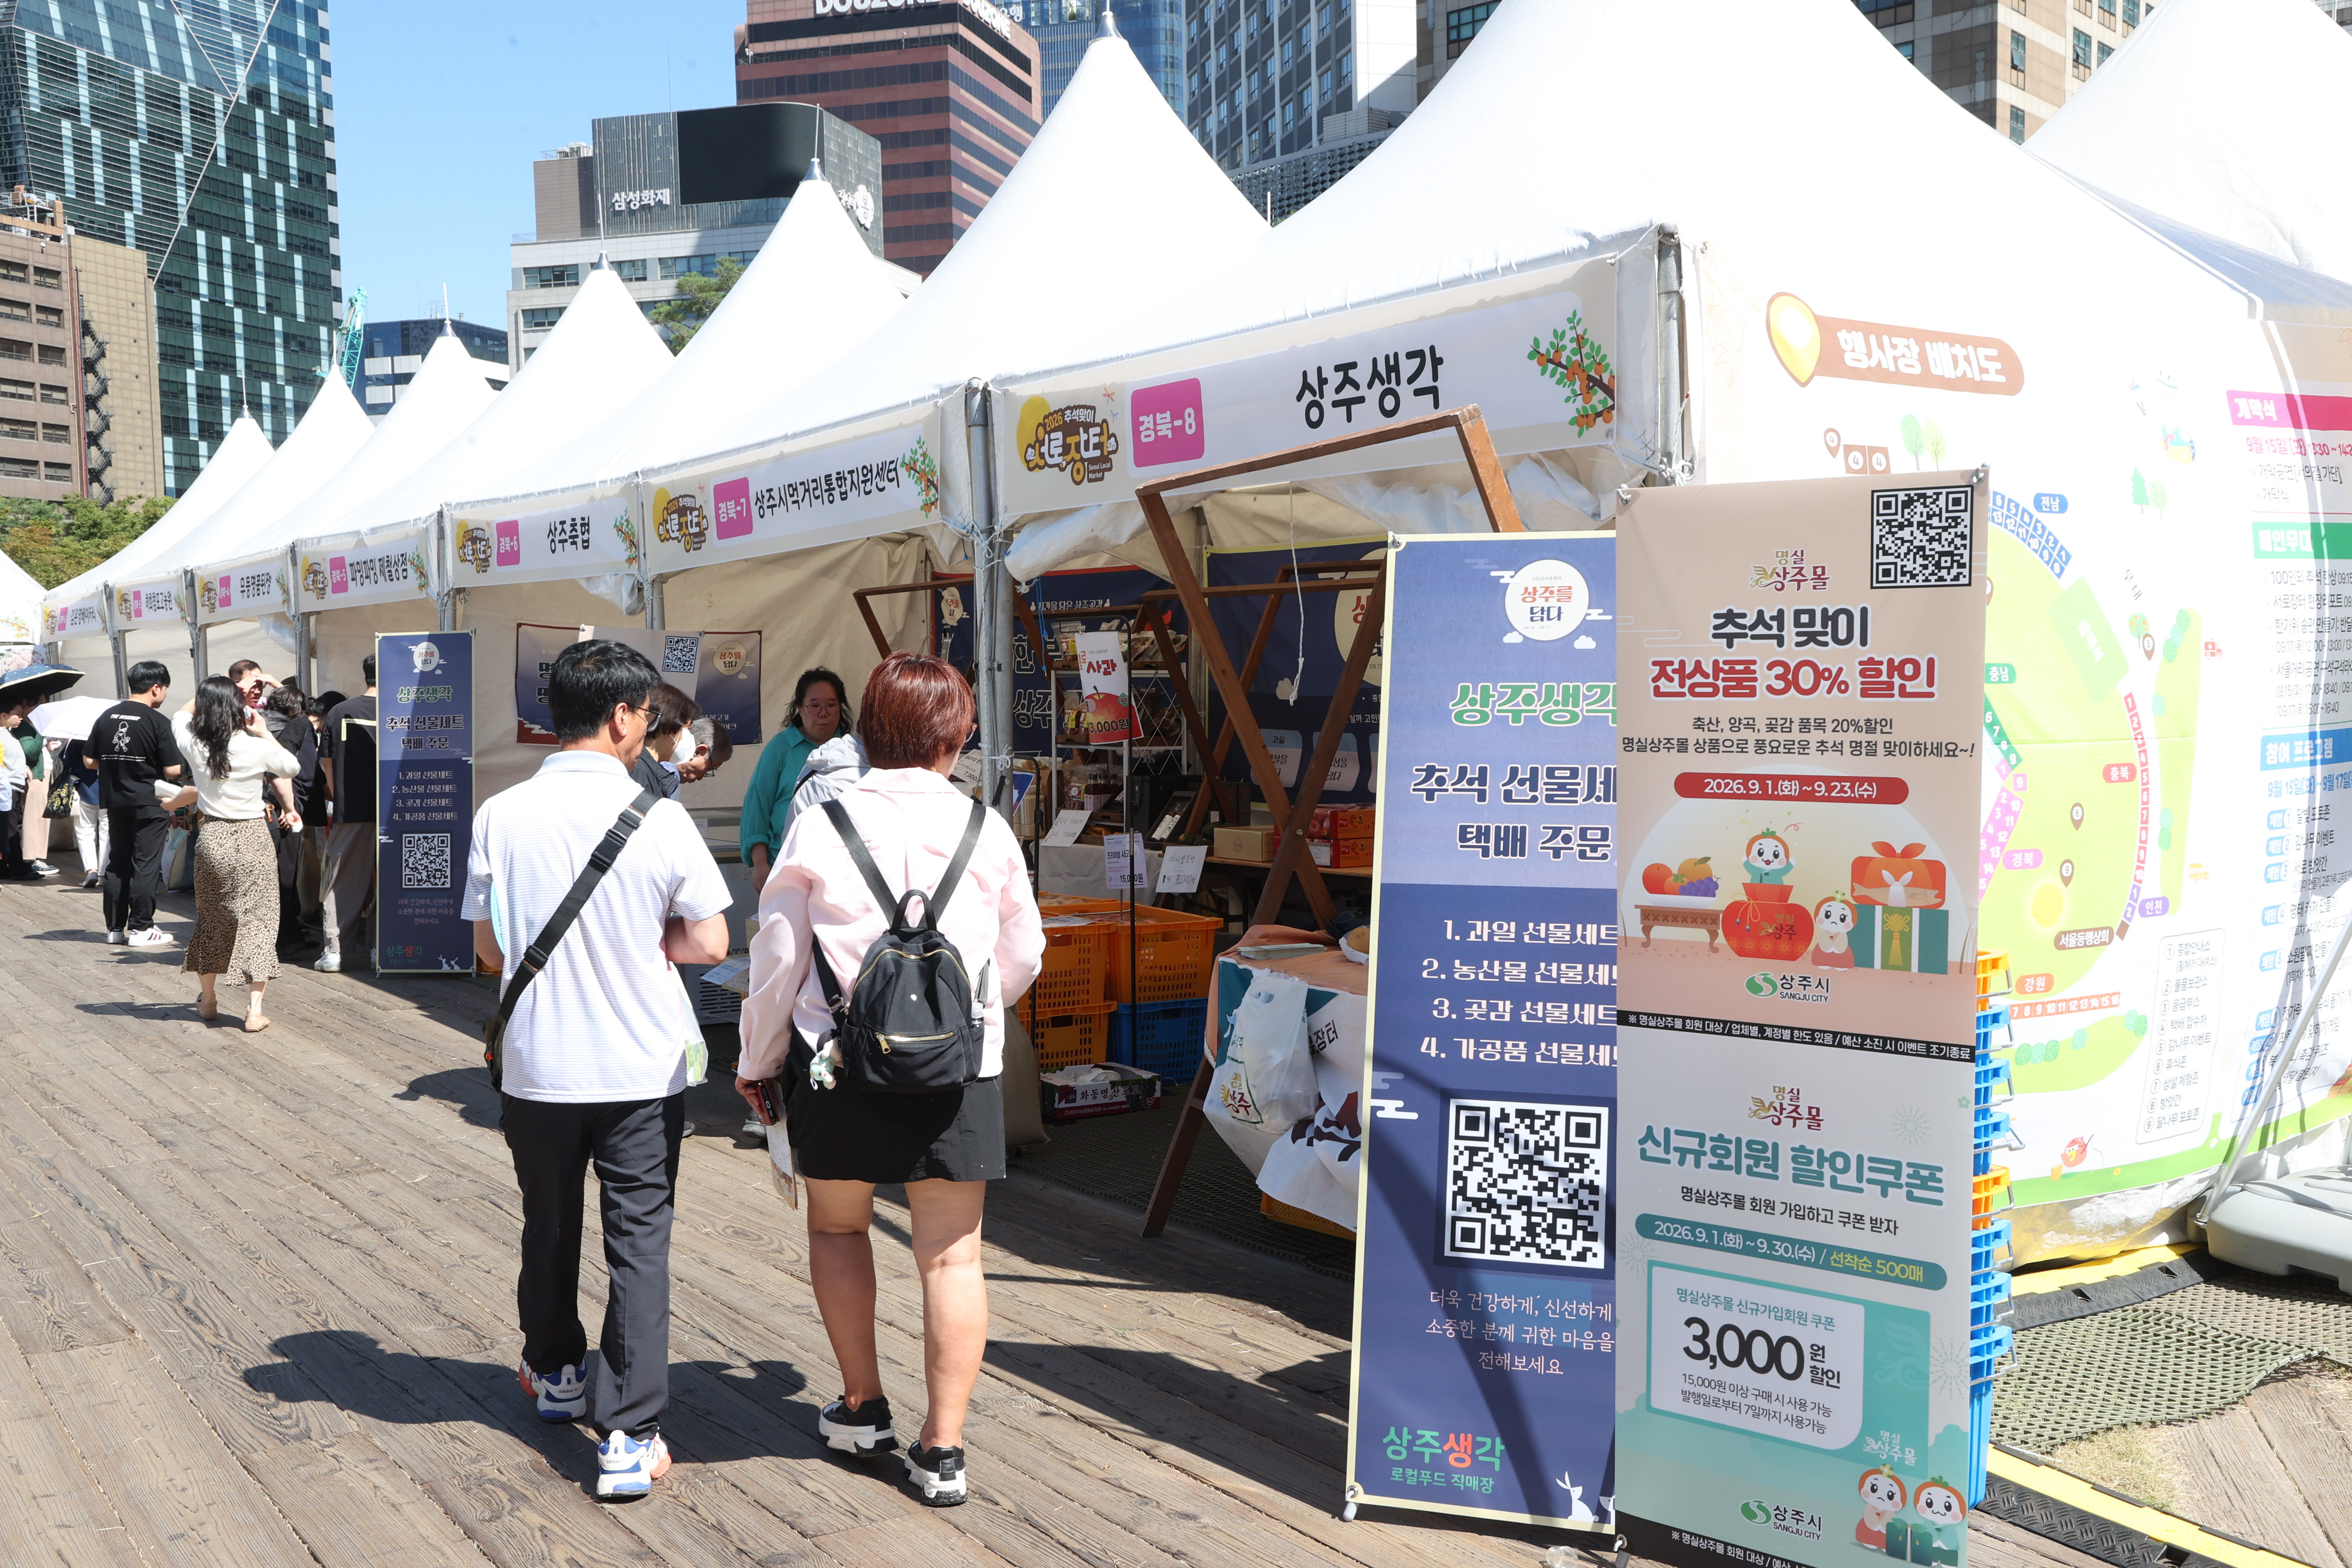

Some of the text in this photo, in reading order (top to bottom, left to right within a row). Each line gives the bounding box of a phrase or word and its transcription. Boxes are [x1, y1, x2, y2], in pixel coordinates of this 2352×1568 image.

[611, 188, 671, 211] 삼성화재
[1836, 329, 2007, 383] 행사장 배치도
[1295, 344, 1445, 430] 상주생각
[2234, 398, 2277, 421] 개막식
[1044, 408, 1094, 431] 2026 추석맞이
[1138, 407, 1197, 443] 경북-8
[754, 457, 901, 519] 상주시먹거리통합지원센터
[668, 496, 696, 514] 2026 추석맞이
[718, 498, 747, 523] 경북-7
[2041, 496, 2060, 511] 전남
[499, 536, 518, 553] 경북-6
[547, 516, 590, 554] 상주축협
[2258, 529, 2313, 551] 메인무대
[1774, 549, 1805, 565] 명실
[349, 552, 407, 587] 파밍파밍 제철상점
[1767, 564, 1831, 592] 상주몰
[1520, 585, 1573, 603] 상주를
[1529, 606, 1564, 622] 담다
[1711, 606, 1870, 649] 추석 맞이
[719, 651, 741, 660] 상주를
[1087, 659, 1117, 676] 사과
[1989, 666, 2009, 682] 충남
[1650, 656, 1936, 699] 전상품 30% 할인
[397, 686, 453, 703] 상주생각
[1449, 683, 1617, 726] 상주생각
[386, 715, 464, 731] 추석 선물세트
[1692, 717, 1893, 735] 축산, 양곡, 곶감 품목 20%할인
[401, 736, 448, 750] 택배 주문
[1273, 735, 1285, 744] 과일
[1622, 738, 1690, 754] 명실상주몰
[1693, 738, 1749, 755] 상품으로
[1753, 739, 1811, 756] 풍요로운
[1816, 740, 1845, 757] 추석
[1849, 740, 1879, 756] 명절
[2266, 738, 2334, 765] 참여 프로그램
[398, 772, 404, 780] 1.
[423, 771, 453, 779] 선물세트
[2110, 766, 2129, 781] 충북
[392, 785, 400, 793] 2.
[426, 784, 457, 793] 선물세트
[1411, 763, 1617, 805] 추석 선물세
[428, 812, 458, 821] 선물세트
[2311, 805, 2330, 821] 포토존
[1458, 823, 1612, 862] 택배 주문
[2012, 852, 2034, 867] 경북
[1120, 873, 1143, 883] 15,00원
[2145, 900, 2163, 915] 인천
[1444, 920, 1461, 940] 1.
[1467, 920, 1516, 943] 과일
[2059, 929, 2110, 948] 서울동행상회
[2177, 941, 2211, 957] 종합안내소
[1779, 974, 1831, 993] 상주시
[2024, 976, 2046, 992] 강원
[2174, 976, 2208, 992] 물품보관소
[1779, 991, 1829, 1003] SANGJU CITY
[2172, 996, 2200, 1012] 응급부스
[2171, 1013, 2207, 1031] 택배 접수처
[1639, 1014, 1971, 1060] 명실상주몰 회원 대상 업체별, 계정별 한도 있음 예산 소진 시 이벤트 조기종료
[2165, 1056, 2187, 1071] 휴식존
[2160, 1094, 2181, 1111] 방앗간
[2179, 1108, 2199, 1122] 포토존
[1637, 1124, 1945, 1206] 신규회원 할인쿠폰
[1829, 1250, 1923, 1283] 선착순 500매
[1430, 1289, 1462, 1308] 더욱
[1544, 1298, 1612, 1323] 신선하게
[1426, 1318, 1615, 1353] 소중한 분께 귀한 마음을
[1682, 1316, 1827, 1381] 3,000 원
[1478, 1351, 1564, 1375] 전해보세요
[1809, 1365, 1841, 1390] 할인
[1682, 1373, 1832, 1418] 15,000원 이상 구매 시 사용 가능
[1681, 1389, 1827, 1435] 발행일로부터 7일까지 사용가능
[1382, 1426, 1506, 1472] 상주생각
[1390, 1467, 1494, 1494] 로컬푸드 직매장
